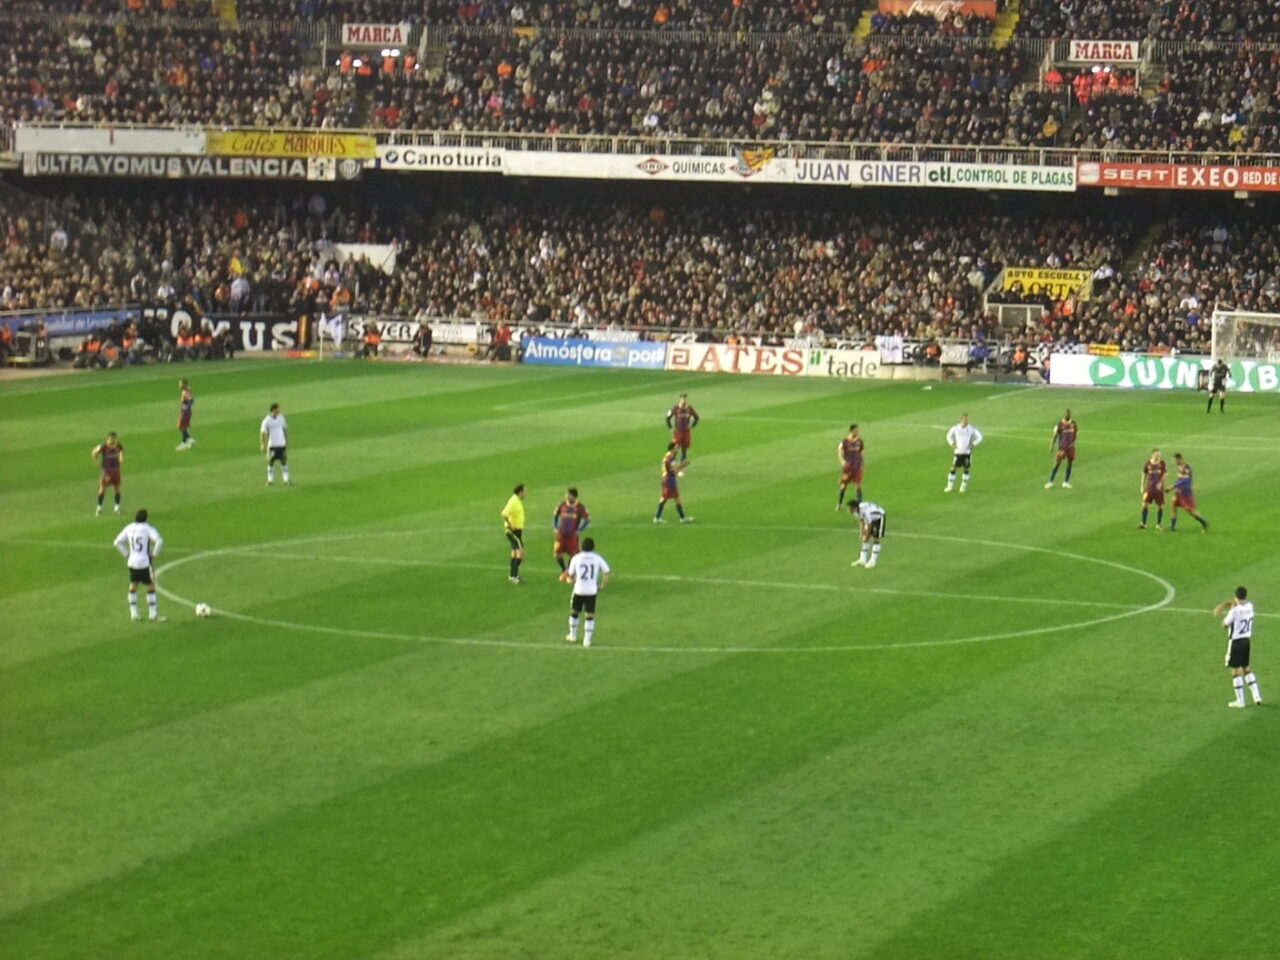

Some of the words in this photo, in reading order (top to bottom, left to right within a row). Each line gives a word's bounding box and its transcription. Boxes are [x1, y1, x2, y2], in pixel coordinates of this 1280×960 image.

[347, 26, 402, 43] MARCA
[1075, 42, 1134, 60] MARCA
[186, 157, 306, 176] VALENCIA
[403, 149, 501, 166] Canoturia
[673, 159, 726, 175] QUÍMICAS
[797, 162, 850, 182] JUAN
[860, 163, 921, 183] GINER
[1103, 168, 1169, 181] SEAT
[956, 168, 1008, 183] CONTROL
[1013, 170, 1027, 184] DE
[1031, 171, 1074, 186] PLAGAS
[1176, 167, 1239, 187] EXEO
[1242, 171, 1262, 184] RED
[1264, 172, 1277, 185] DE
[525, 340, 612, 364] Atmósfera
[700, 344, 804, 375] ATES
[827, 353, 877, 377] tade
[580, 563, 594, 580] 21
